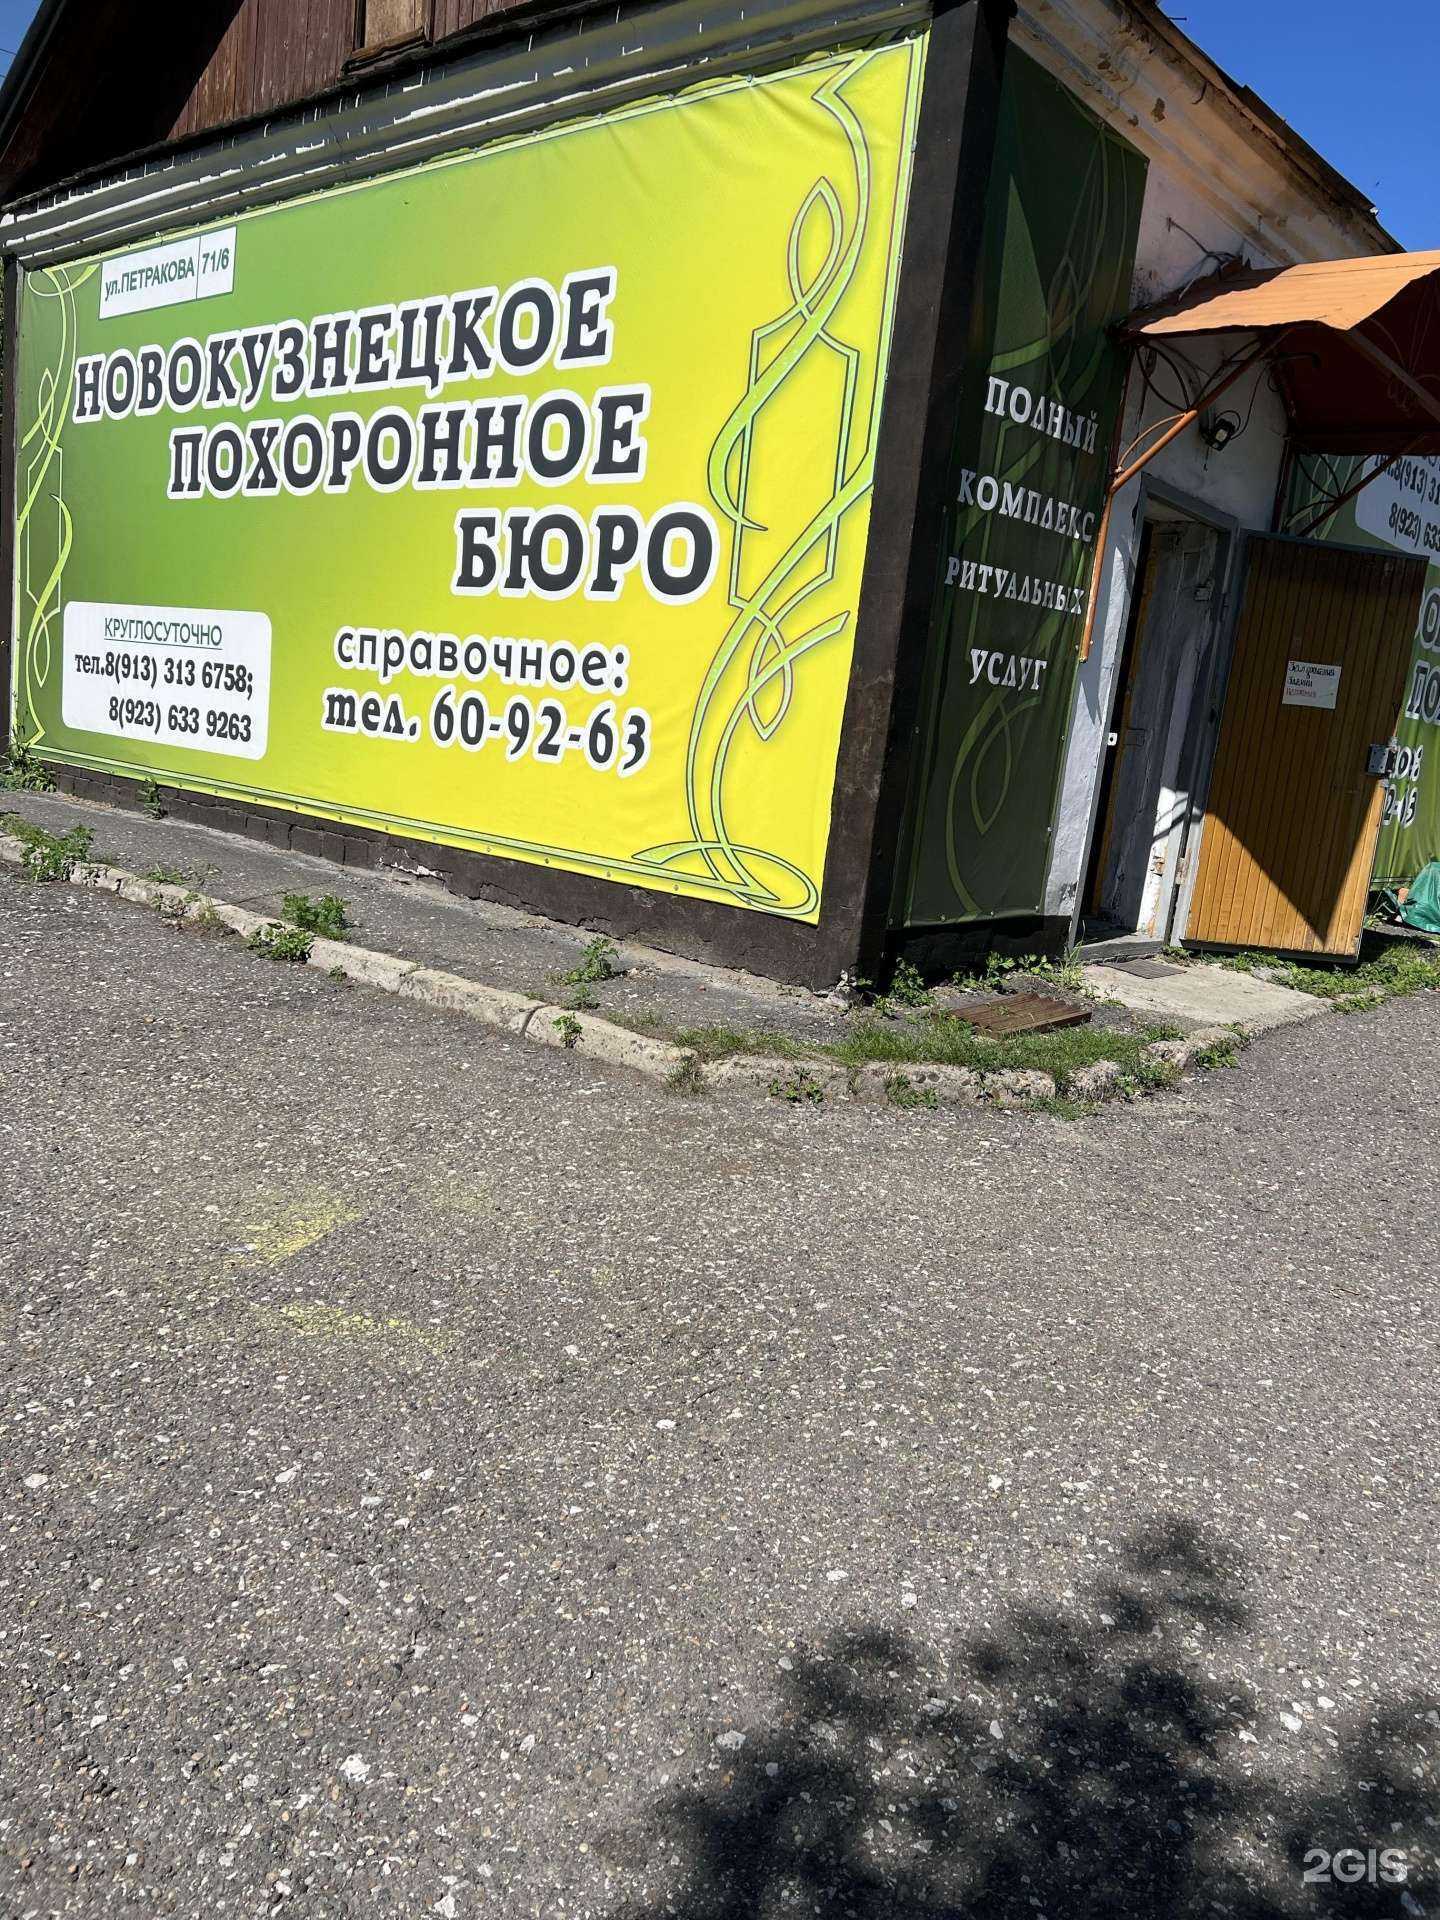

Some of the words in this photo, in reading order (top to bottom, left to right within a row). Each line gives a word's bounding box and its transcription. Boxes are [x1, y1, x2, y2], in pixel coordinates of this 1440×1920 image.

[104, 256, 195, 302] ул.ПЕТРАКОВА
[201, 247, 230, 275] 71/6
[74, 275, 612, 419] НОВОКУЗНЕЦКОЕ
[169, 391, 646, 494] ПОХОРОННОЕ
[983, 375, 1100, 455] ПОЛНЫЙ
[956, 467, 1097, 543] КОМПЛЕКС
[1388, 502, 1422, 548] 8(923)
[455, 510, 714, 597] БЮРО
[943, 555, 1085, 615] РИТУАЛЬНЫХ
[103, 616, 223, 647] КРУГЛОСУТОЧНО
[336, 631, 626, 690] справочное:
[74, 651, 158, 690] тел.8(913)
[163, 657, 196, 687] 313
[201, 660, 253, 701] 6758;
[968, 648, 1048, 692] УСЛУГ
[108, 695, 162, 736] 8(923)
[167, 704, 200, 735] 633
[205, 709, 252, 743] 9263
[324, 692, 418, 738] тел.
[433, 689, 647, 772] 60-92-63
